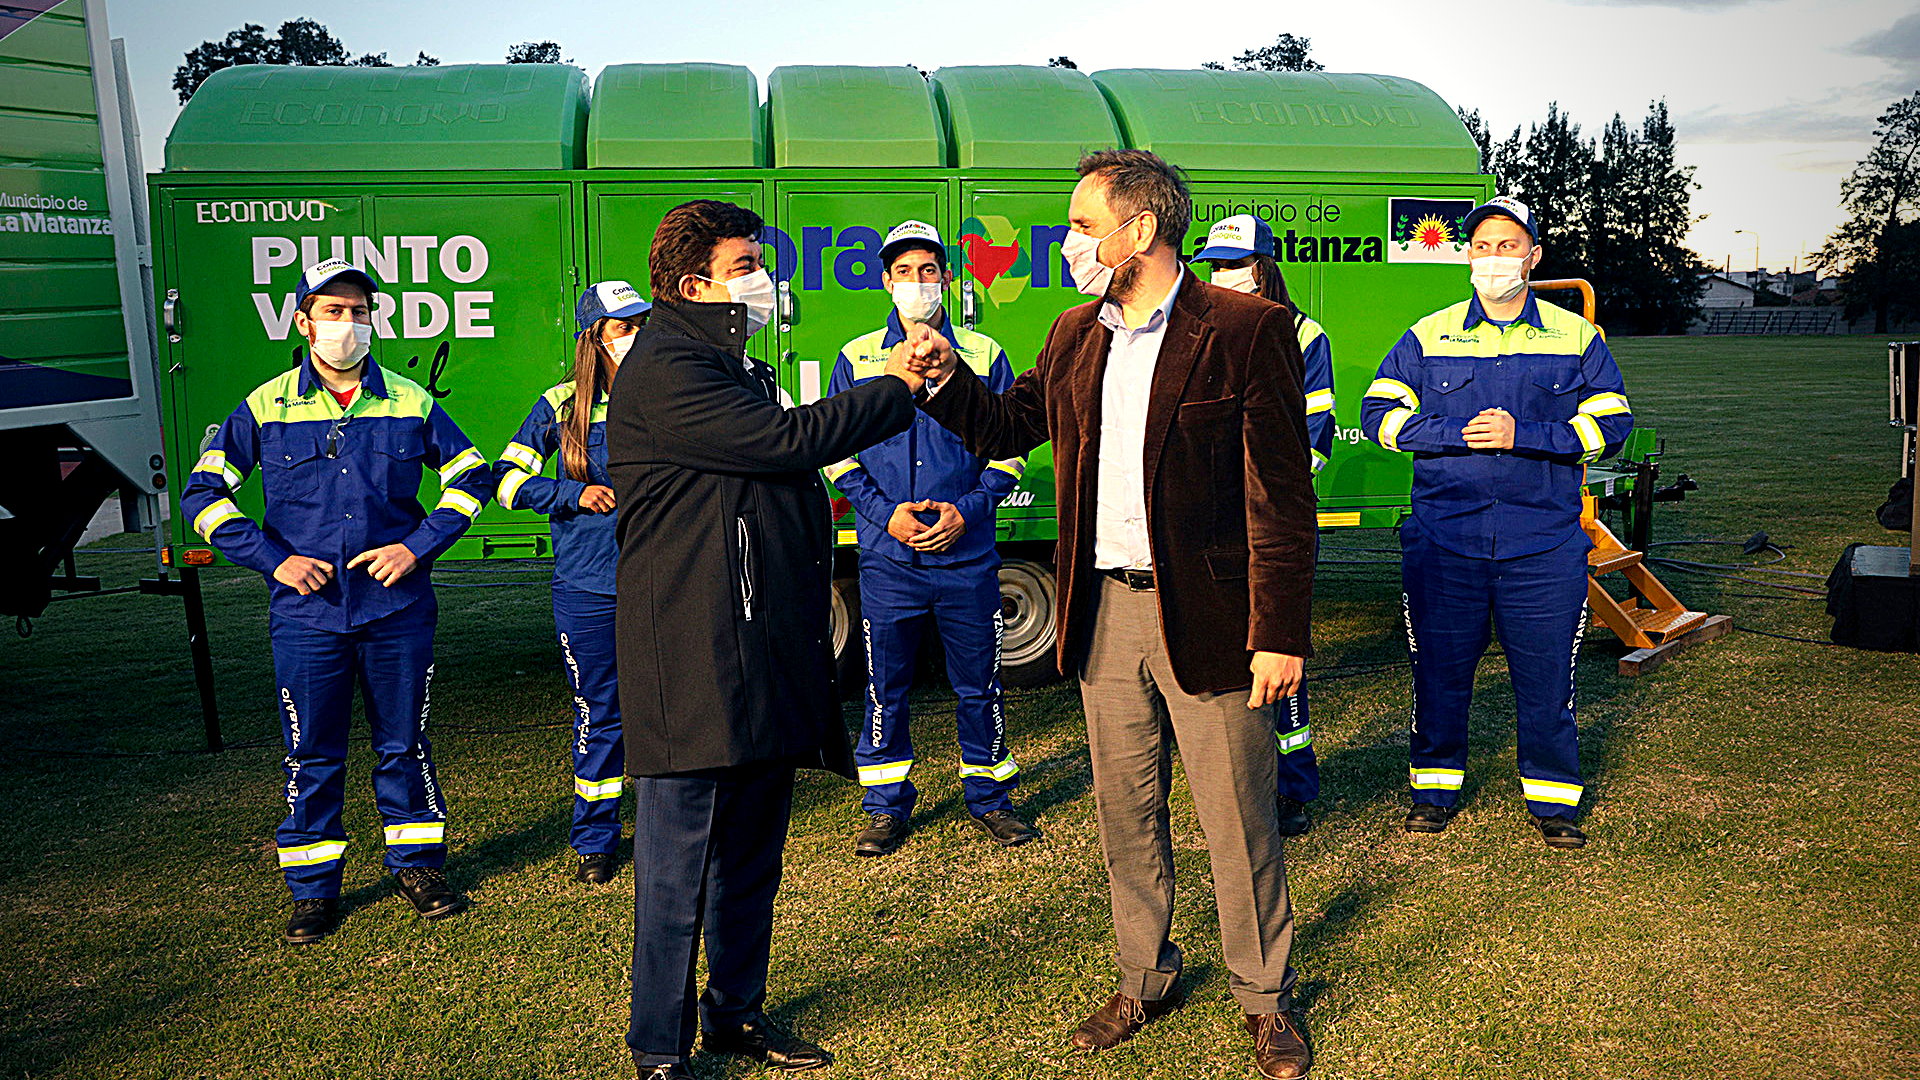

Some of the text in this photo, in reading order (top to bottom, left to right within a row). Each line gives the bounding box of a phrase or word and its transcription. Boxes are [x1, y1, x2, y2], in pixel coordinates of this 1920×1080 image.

[0, 192, 88, 211] Municipio de
[1188, 199, 1341, 223] unicipio de
[20, 212, 114, 235] Matanza
[251, 291, 496, 340] VRDE
